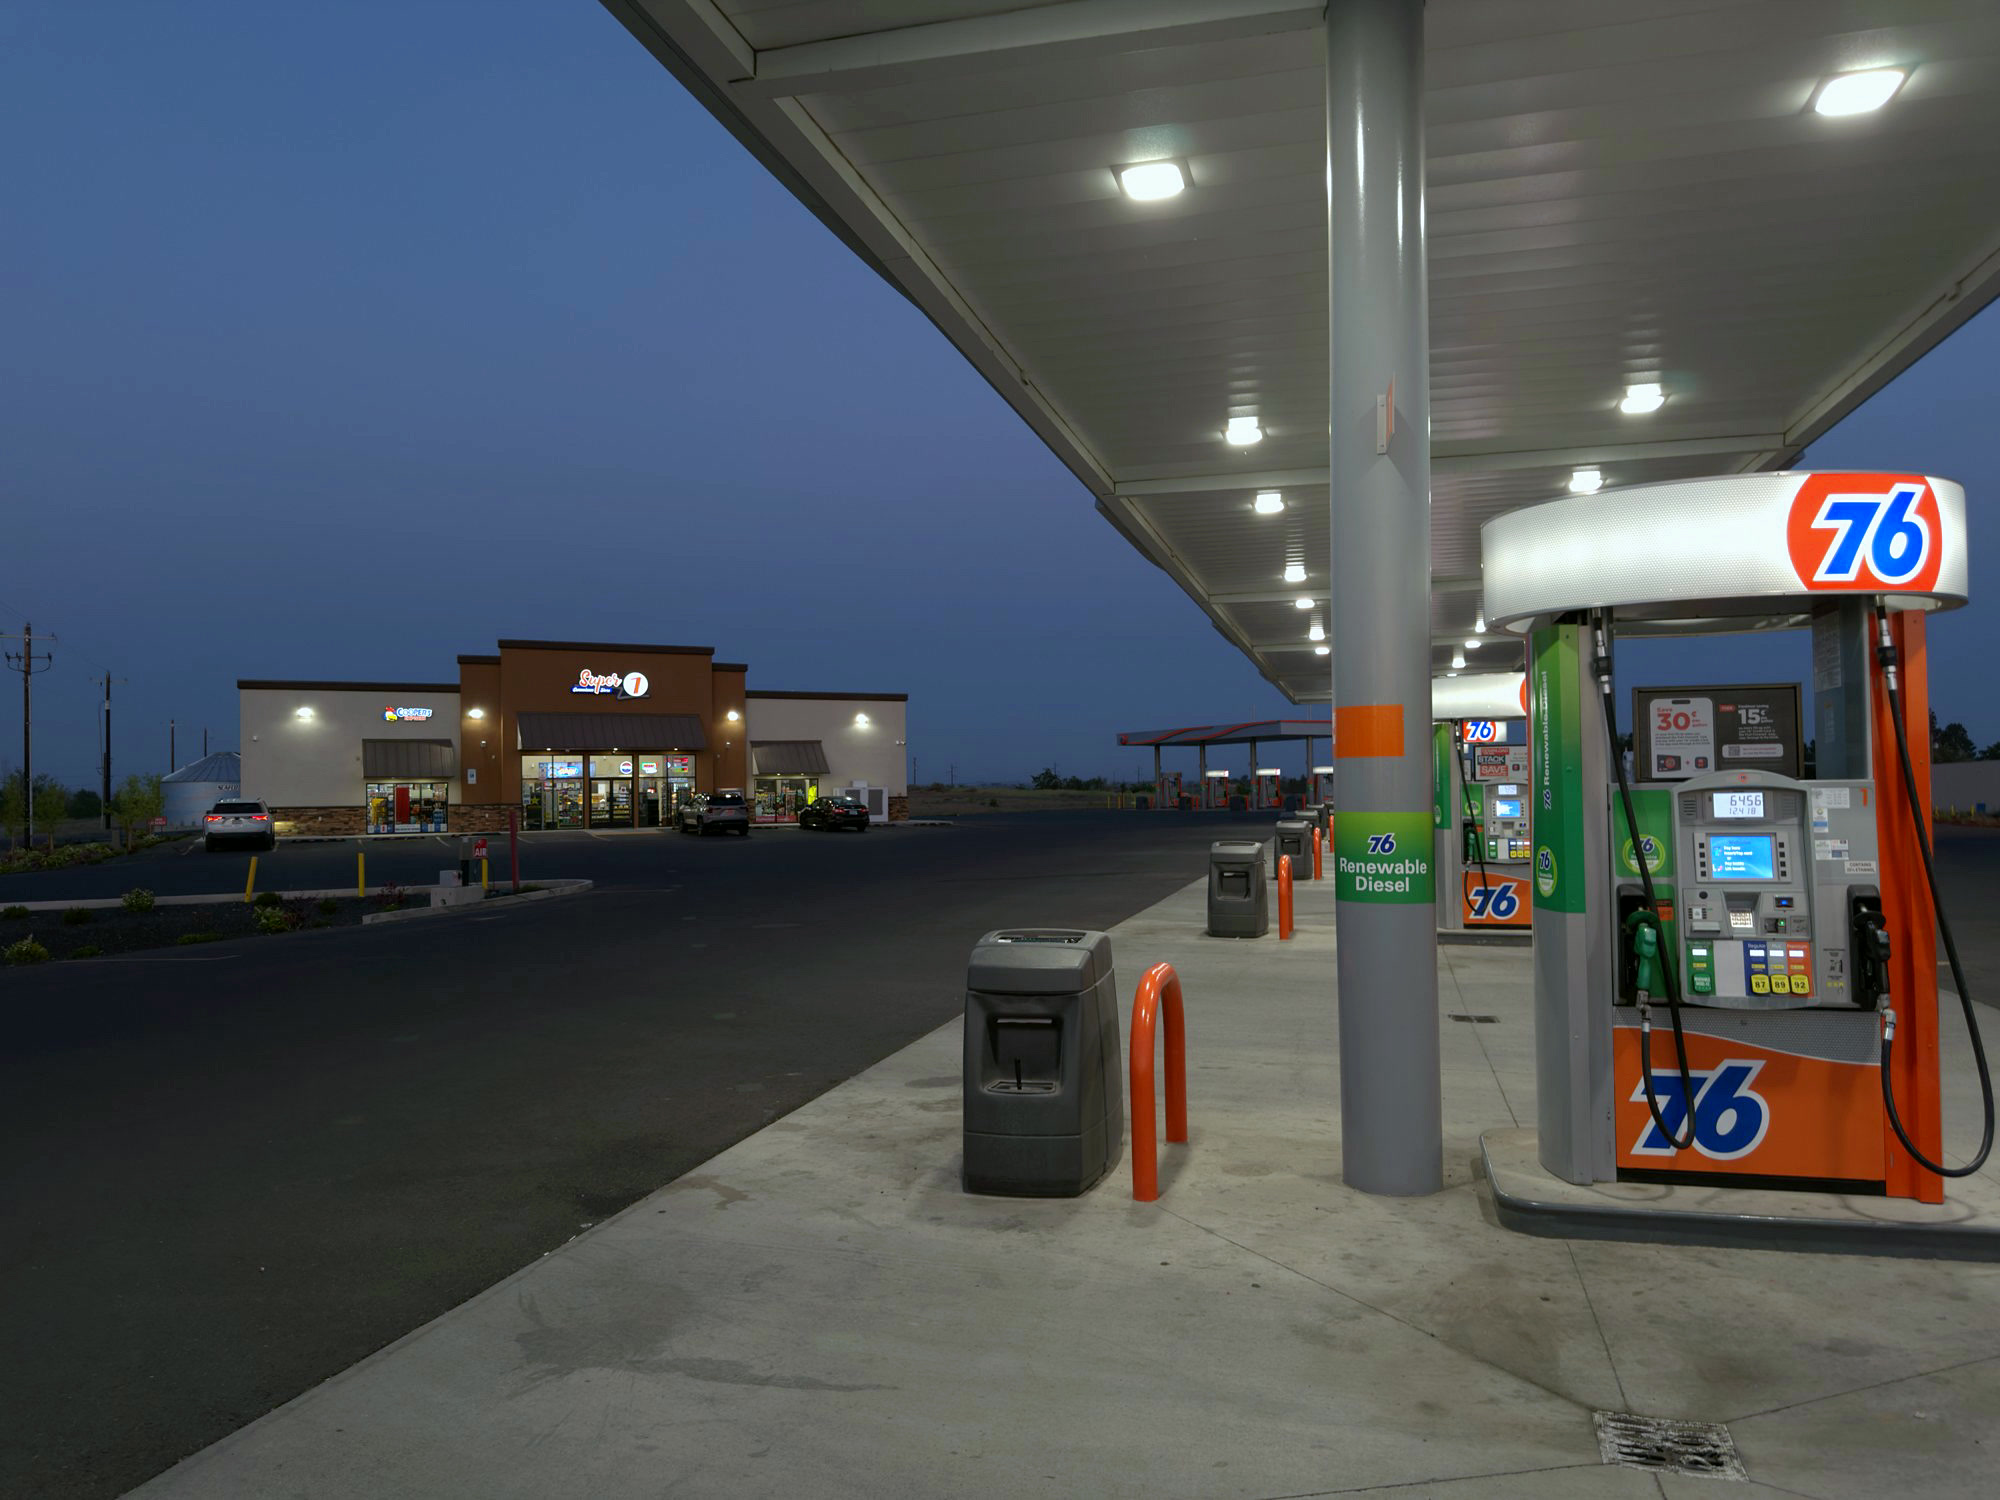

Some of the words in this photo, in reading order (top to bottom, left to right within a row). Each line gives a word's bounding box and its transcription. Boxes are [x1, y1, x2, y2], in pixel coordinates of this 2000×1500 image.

[1811, 483, 1926, 584] 76
[579, 669, 622, 694] Super
[1466, 722, 1494, 740] 76
[1481, 765, 1507, 775] SAVE
[1543, 789, 1552, 810] 76
[474, 848, 487, 857] AIR
[1368, 833, 1396, 855] 76
[1340, 857, 1427, 875] Renewable
[1540, 850, 1551, 870] 76
[1356, 876, 1409, 892] Diesel
[1469, 883, 1519, 919] 76
[1794, 981, 1806, 989] 92
[1629, 1059, 1770, 1160] 76
